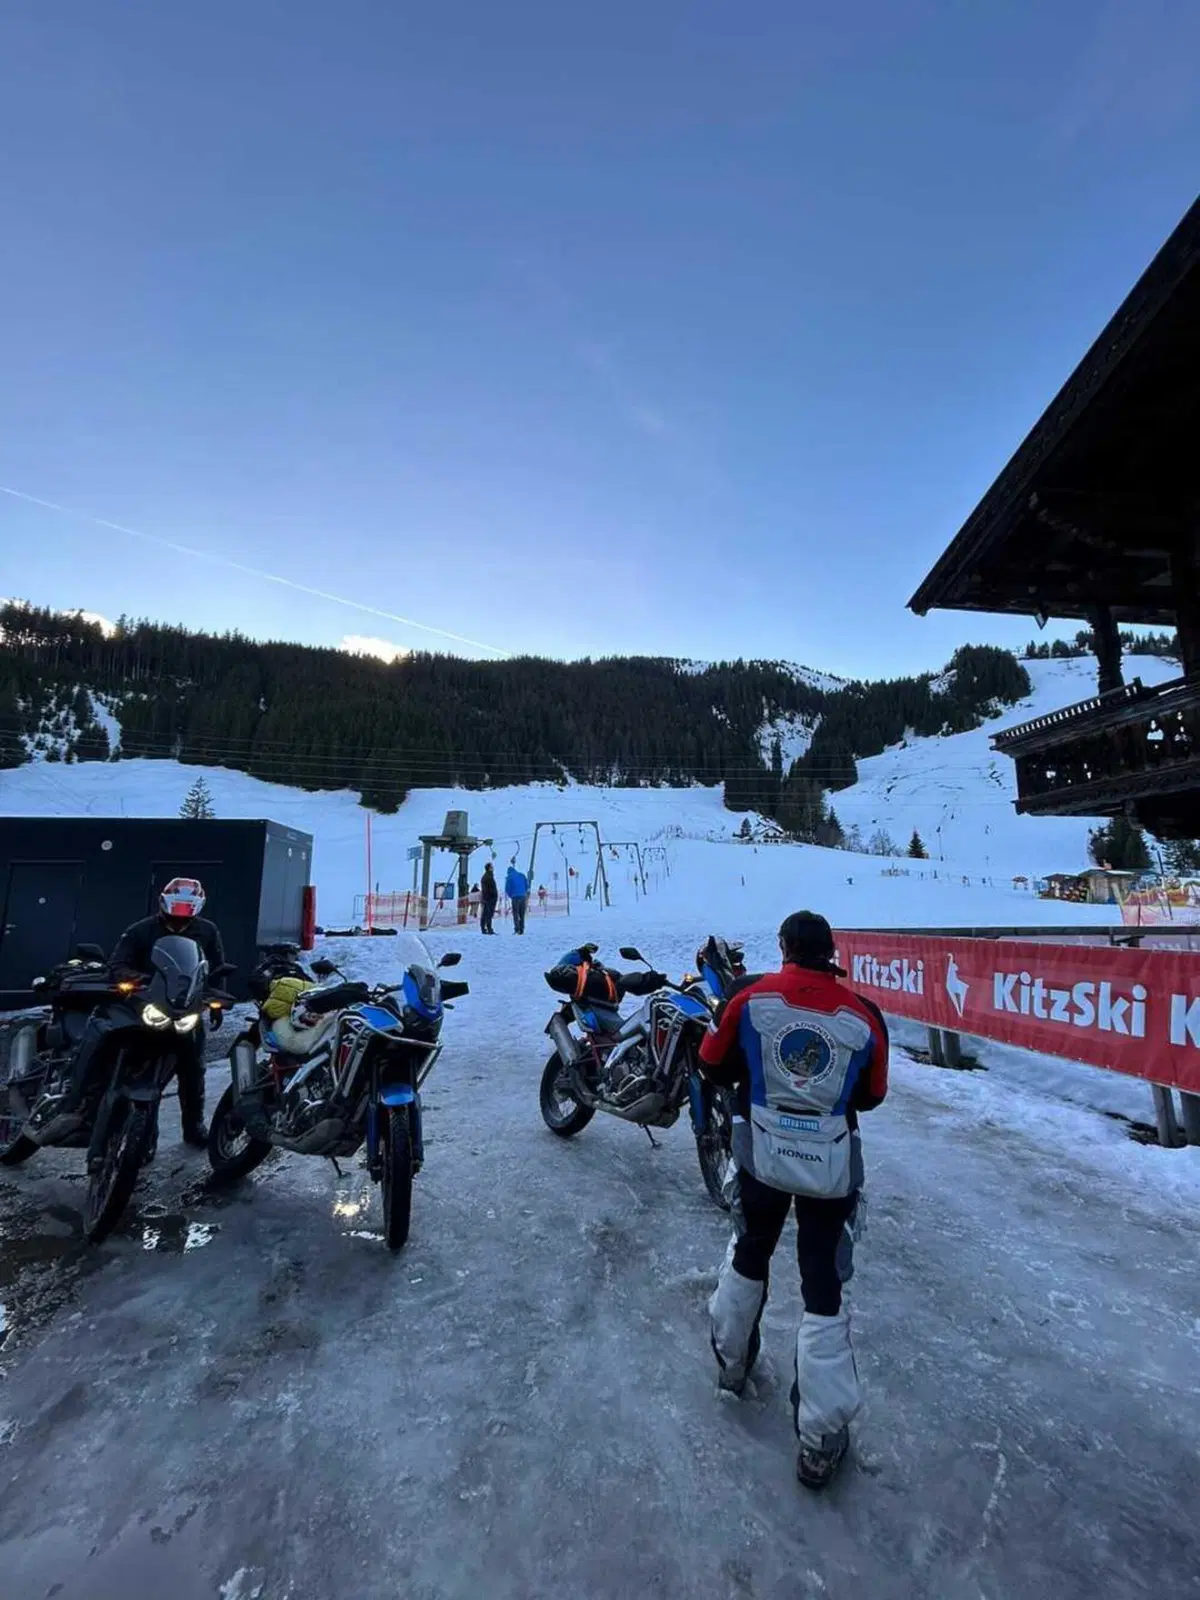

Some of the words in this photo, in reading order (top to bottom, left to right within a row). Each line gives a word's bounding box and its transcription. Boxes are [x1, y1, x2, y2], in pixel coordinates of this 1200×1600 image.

[853, 953, 924, 995] KitzSki
[993, 971, 1148, 1038] KitzSki
[777, 1147, 824, 1163] HONDA
